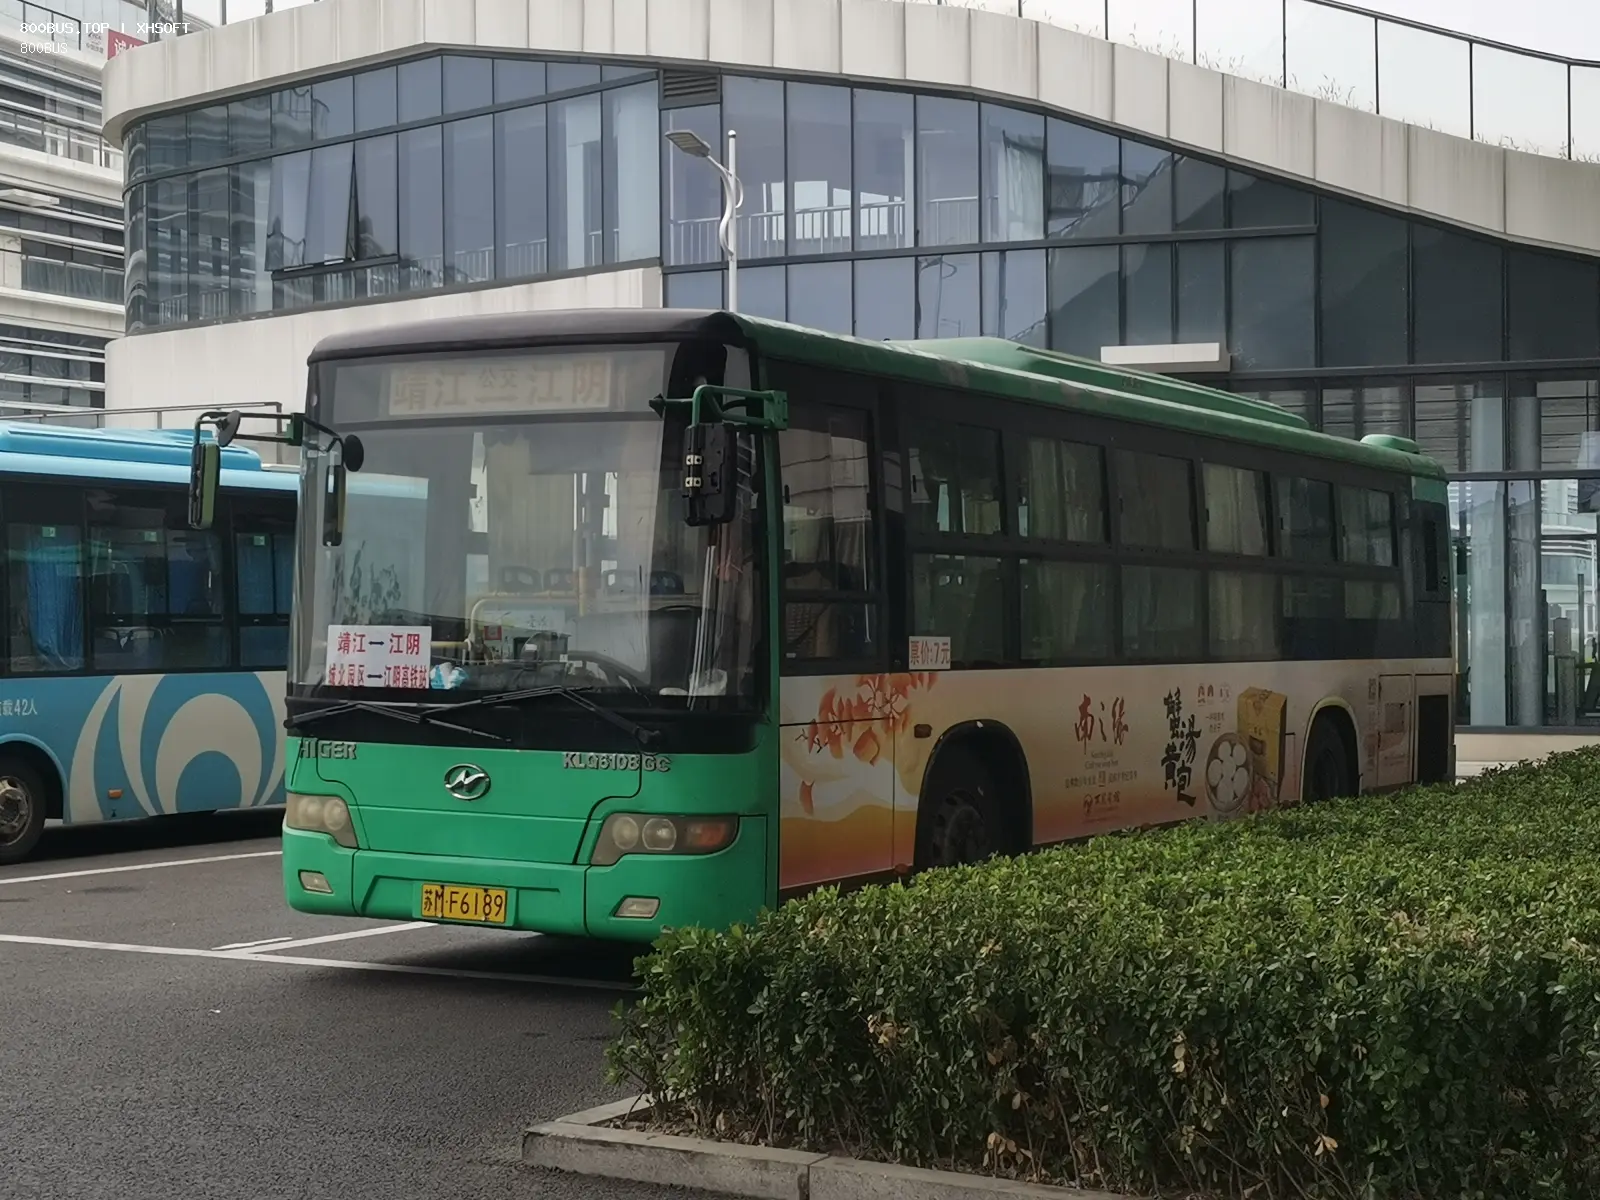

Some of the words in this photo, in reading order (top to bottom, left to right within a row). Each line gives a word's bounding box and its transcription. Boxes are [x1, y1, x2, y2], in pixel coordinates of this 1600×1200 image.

[394, 370, 467, 411] 靖江
[478, 366, 518, 389] 公交
[526, 359, 607, 406] 江阴
[337, 631, 366, 655] 靖江
[389, 632, 420, 655] 江阴
[0, 698, 38, 716] 载42人
[300, 738, 357, 760] HIGER
